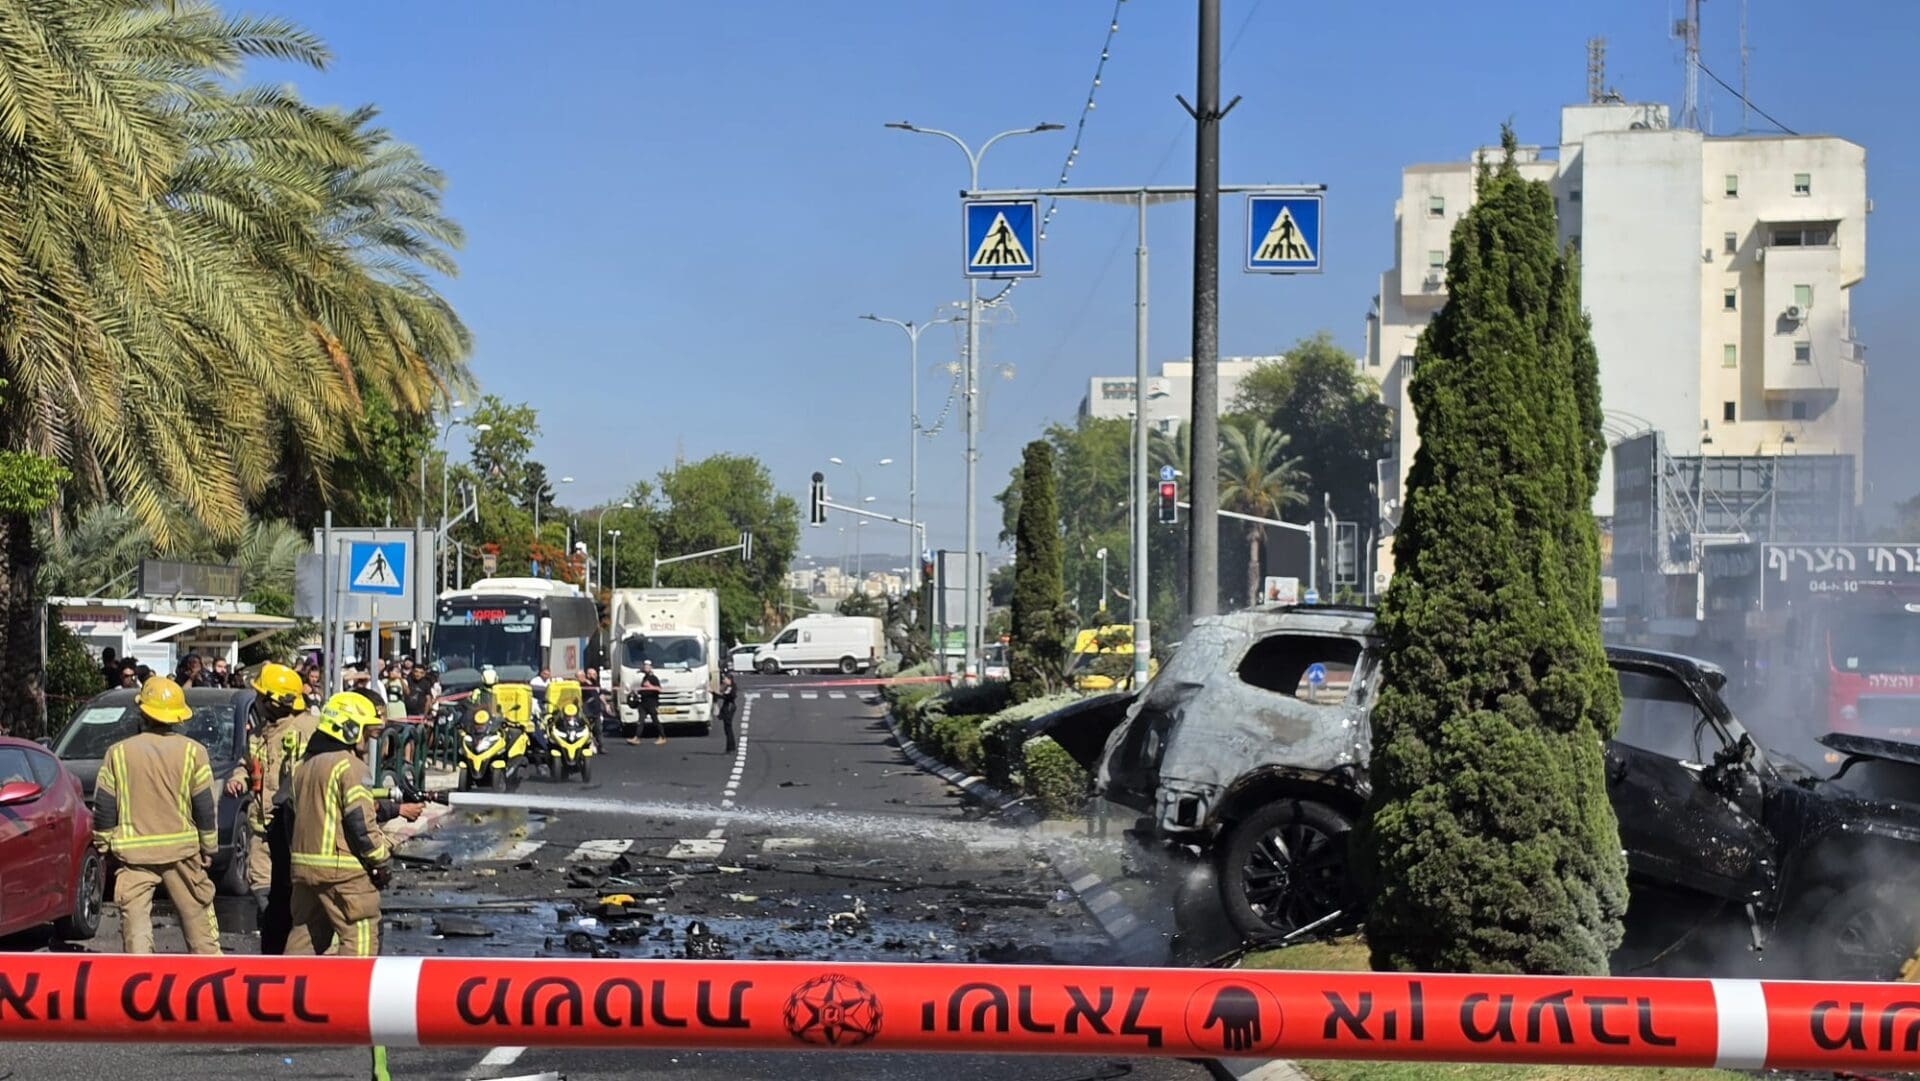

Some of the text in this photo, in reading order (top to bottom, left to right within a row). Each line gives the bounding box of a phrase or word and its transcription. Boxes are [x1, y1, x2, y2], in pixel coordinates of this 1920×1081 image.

[1768, 547, 1857, 581] הצריף
[1867, 547, 1920, 572] רחי
[1869, 673, 1914, 688] והצלה
[120, 967, 330, 1024] מעבר
[455, 975, 1166, 1048] משטרת ישראל
[1322, 980, 1678, 1047] אין מעבר
